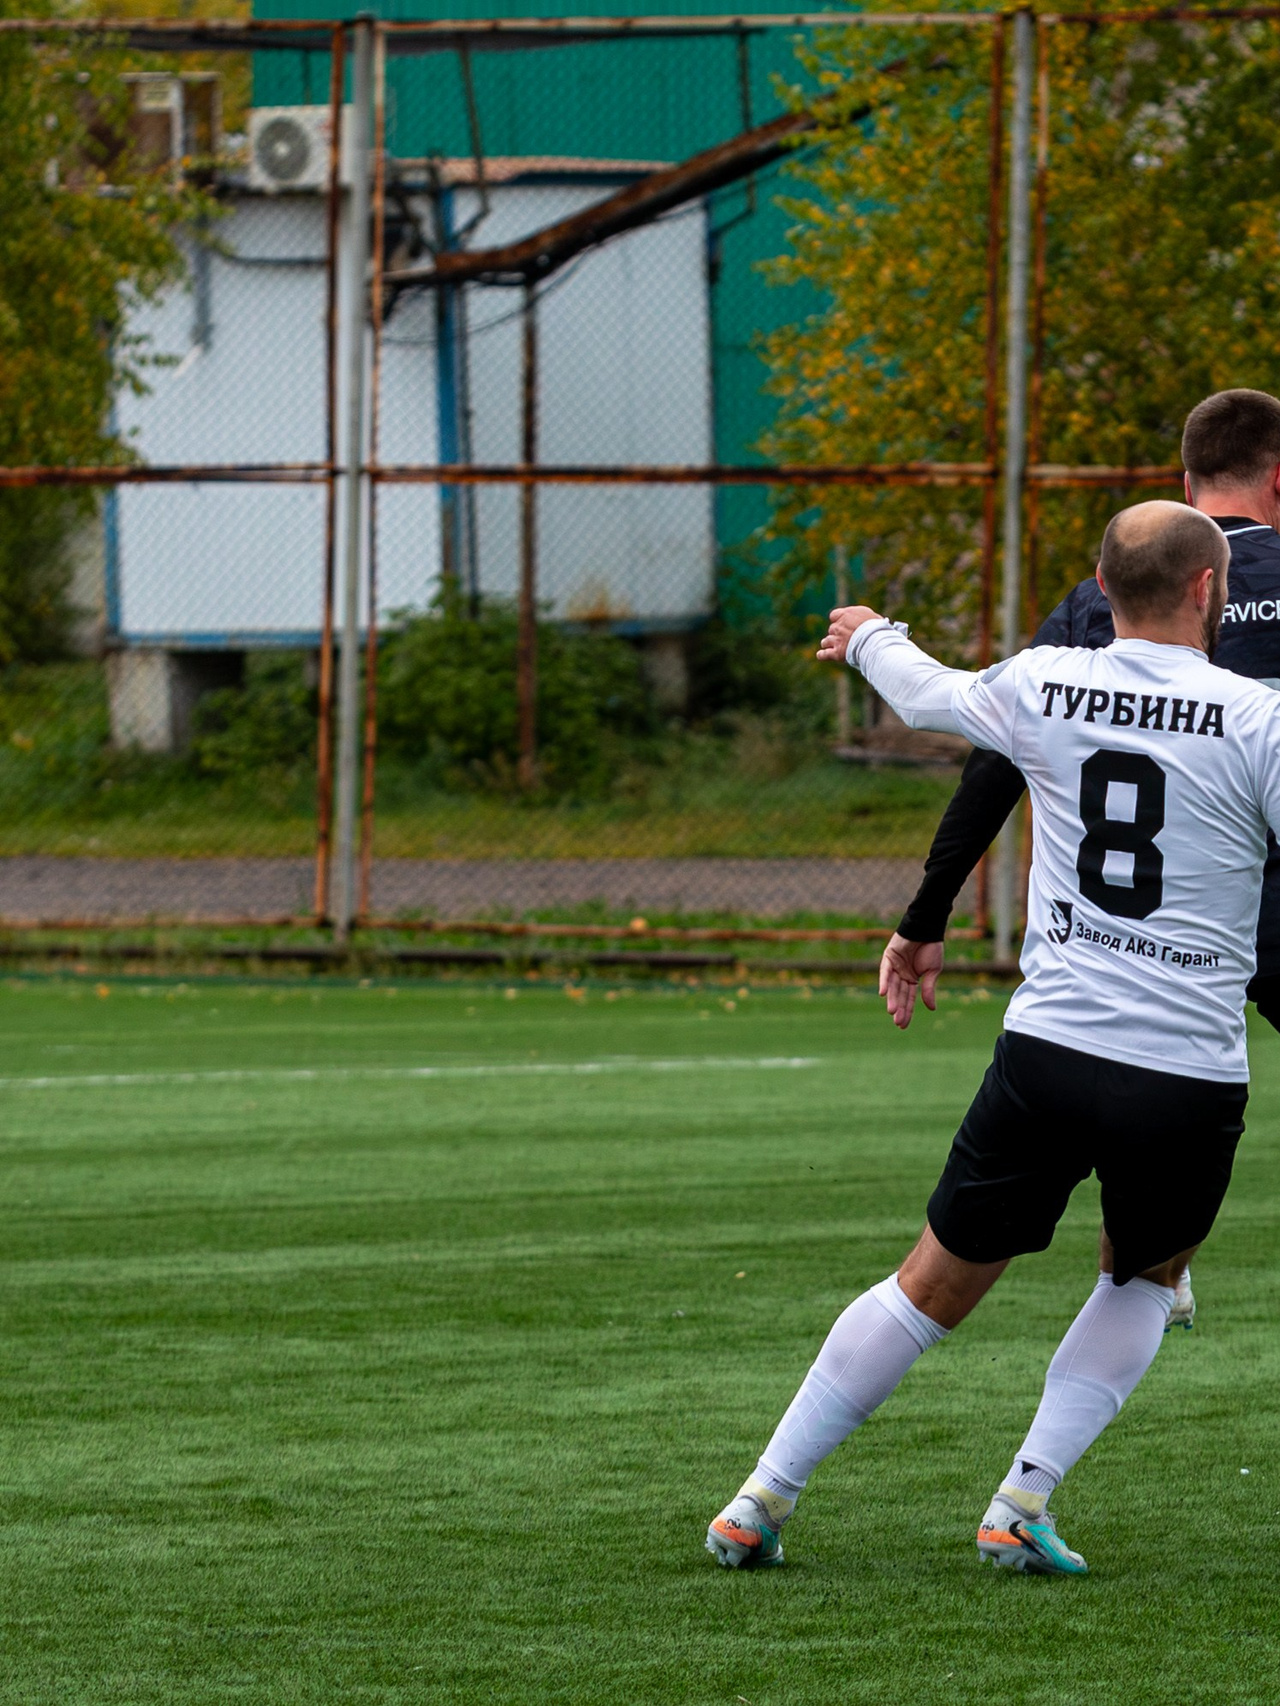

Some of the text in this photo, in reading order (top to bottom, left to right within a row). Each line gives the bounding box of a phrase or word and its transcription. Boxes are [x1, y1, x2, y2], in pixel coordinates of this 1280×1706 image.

[1041, 681, 1225, 738] ТУРБИНА
[1076, 748, 1166, 921] 8
[1076, 922, 1220, 968] Завод АКЗ Гарант
